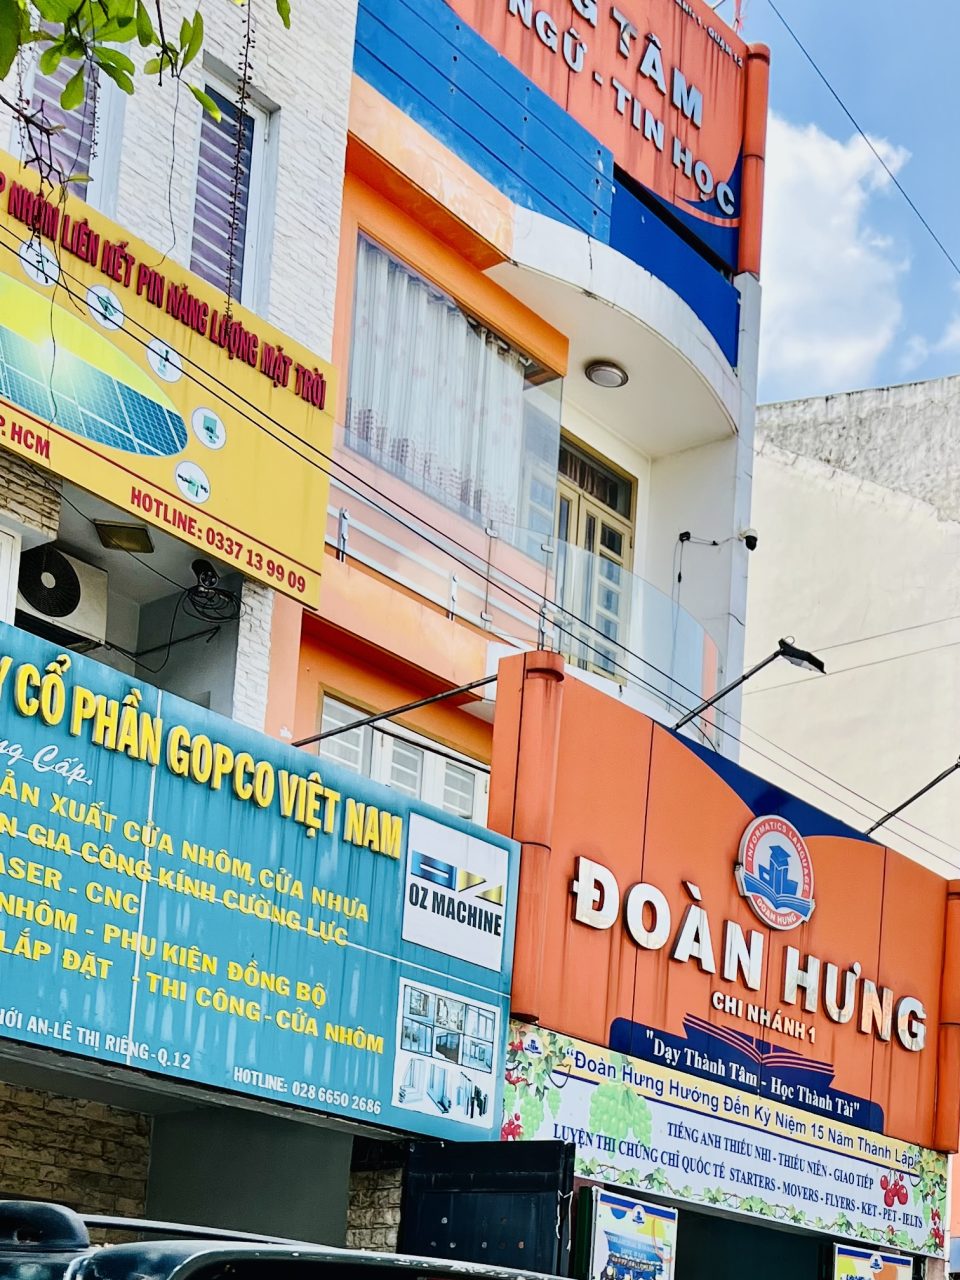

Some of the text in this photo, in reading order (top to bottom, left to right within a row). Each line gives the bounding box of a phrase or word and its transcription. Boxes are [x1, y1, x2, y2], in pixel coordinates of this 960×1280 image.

[610, 6, 703, 128] TÂM
[611, 77, 664, 152] TIN
[672, 137, 735, 215] HỌC
[61, 214, 100, 267] LIÊN
[101, 240, 135, 288] KẾT
[136, 265, 164, 309] PIN
[166, 283, 209, 336] NĂNG
[210, 312, 259, 369] LƯỢNG
[260, 345, 293, 390] MẶT
[295, 360, 327, 411] TRỜI
[11, 421, 50, 460] HCM
[131, 486, 306, 594] HOTLINE: 0337 13 99 09
[14, 653, 71, 727] CỔ
[70, 688, 163, 767] PHẦN
[166, 724, 275, 809] GOPCO
[278, 771, 341, 839] VIỆT
[343, 798, 403, 861] NAM
[50, 793, 117, 833] XUẤT
[123, 816, 173, 855] CỬA
[181, 839, 255, 885] NHÔM,
[259, 867, 304, 900] CỬA
[747, 822, 787, 861] INFORMATICS
[788, 831, 811, 893] LANGUAGE
[27, 823, 71, 855] GIA
[81, 841, 152, 882] CÔNG
[158, 867, 216, 904] KÍNH
[222, 889, 301, 931] CƯỜNG
[306, 917, 348, 947] LỰC
[85, 881, 140, 914] CNC
[408, 883, 502, 937] OZ MACHINE
[0, 927, 384, 1055] LẮP ĐẶT THI CÔNG CỬA NHÔM
[103, 926, 156, 959] PHỤ
[162, 945, 218, 976] KIỆN
[227, 959, 290, 997] ĐỒNG
[296, 981, 327, 1010] BỘ
[570, 856, 927, 1052] ĐOÀN HƯNG
[76, 1026, 100, 1052] THỊ
[712, 991, 817, 1044] CHI NHÁNH 1
[233, 1067, 382, 1115] HOTLINE: 028 6650 2686
[622, 1065, 664, 1096] Hưng
[669, 1081, 719, 1112] Hướng
[723, 1095, 750, 1117] Đến
[775, 1116, 807, 1136] Niệm
[811, 1123, 824, 1139] 15
[828, 1128, 854, 1148] Năm
[684, 1047, 726, 1077] Thành
[729, 1062, 758, 1087] Tâm
[771, 1076, 794, 1101] Học
[797, 1086, 834, 1111] Thành
[553, 1123, 593, 1149] LUYỆN
[596, 1134, 615, 1152] THI
[618, 1138, 658, 1163] CHỨNG
[660, 1150, 680, 1168] CHỈ
[729, 1168, 776, 1193] STARTERS
[782, 1181, 819, 1203] MOVERS
[825, 1192, 856, 1213] FLYERS
[861, 1201, 877, 1218] KET
[882, 1207, 898, 1223] PET
[902, 1212, 923, 1230] IELTS
[700, 1132, 722, 1149] ANH
[754, 1146, 771, 1163] NHI
[833, 1169, 855, 1186] GIAO
